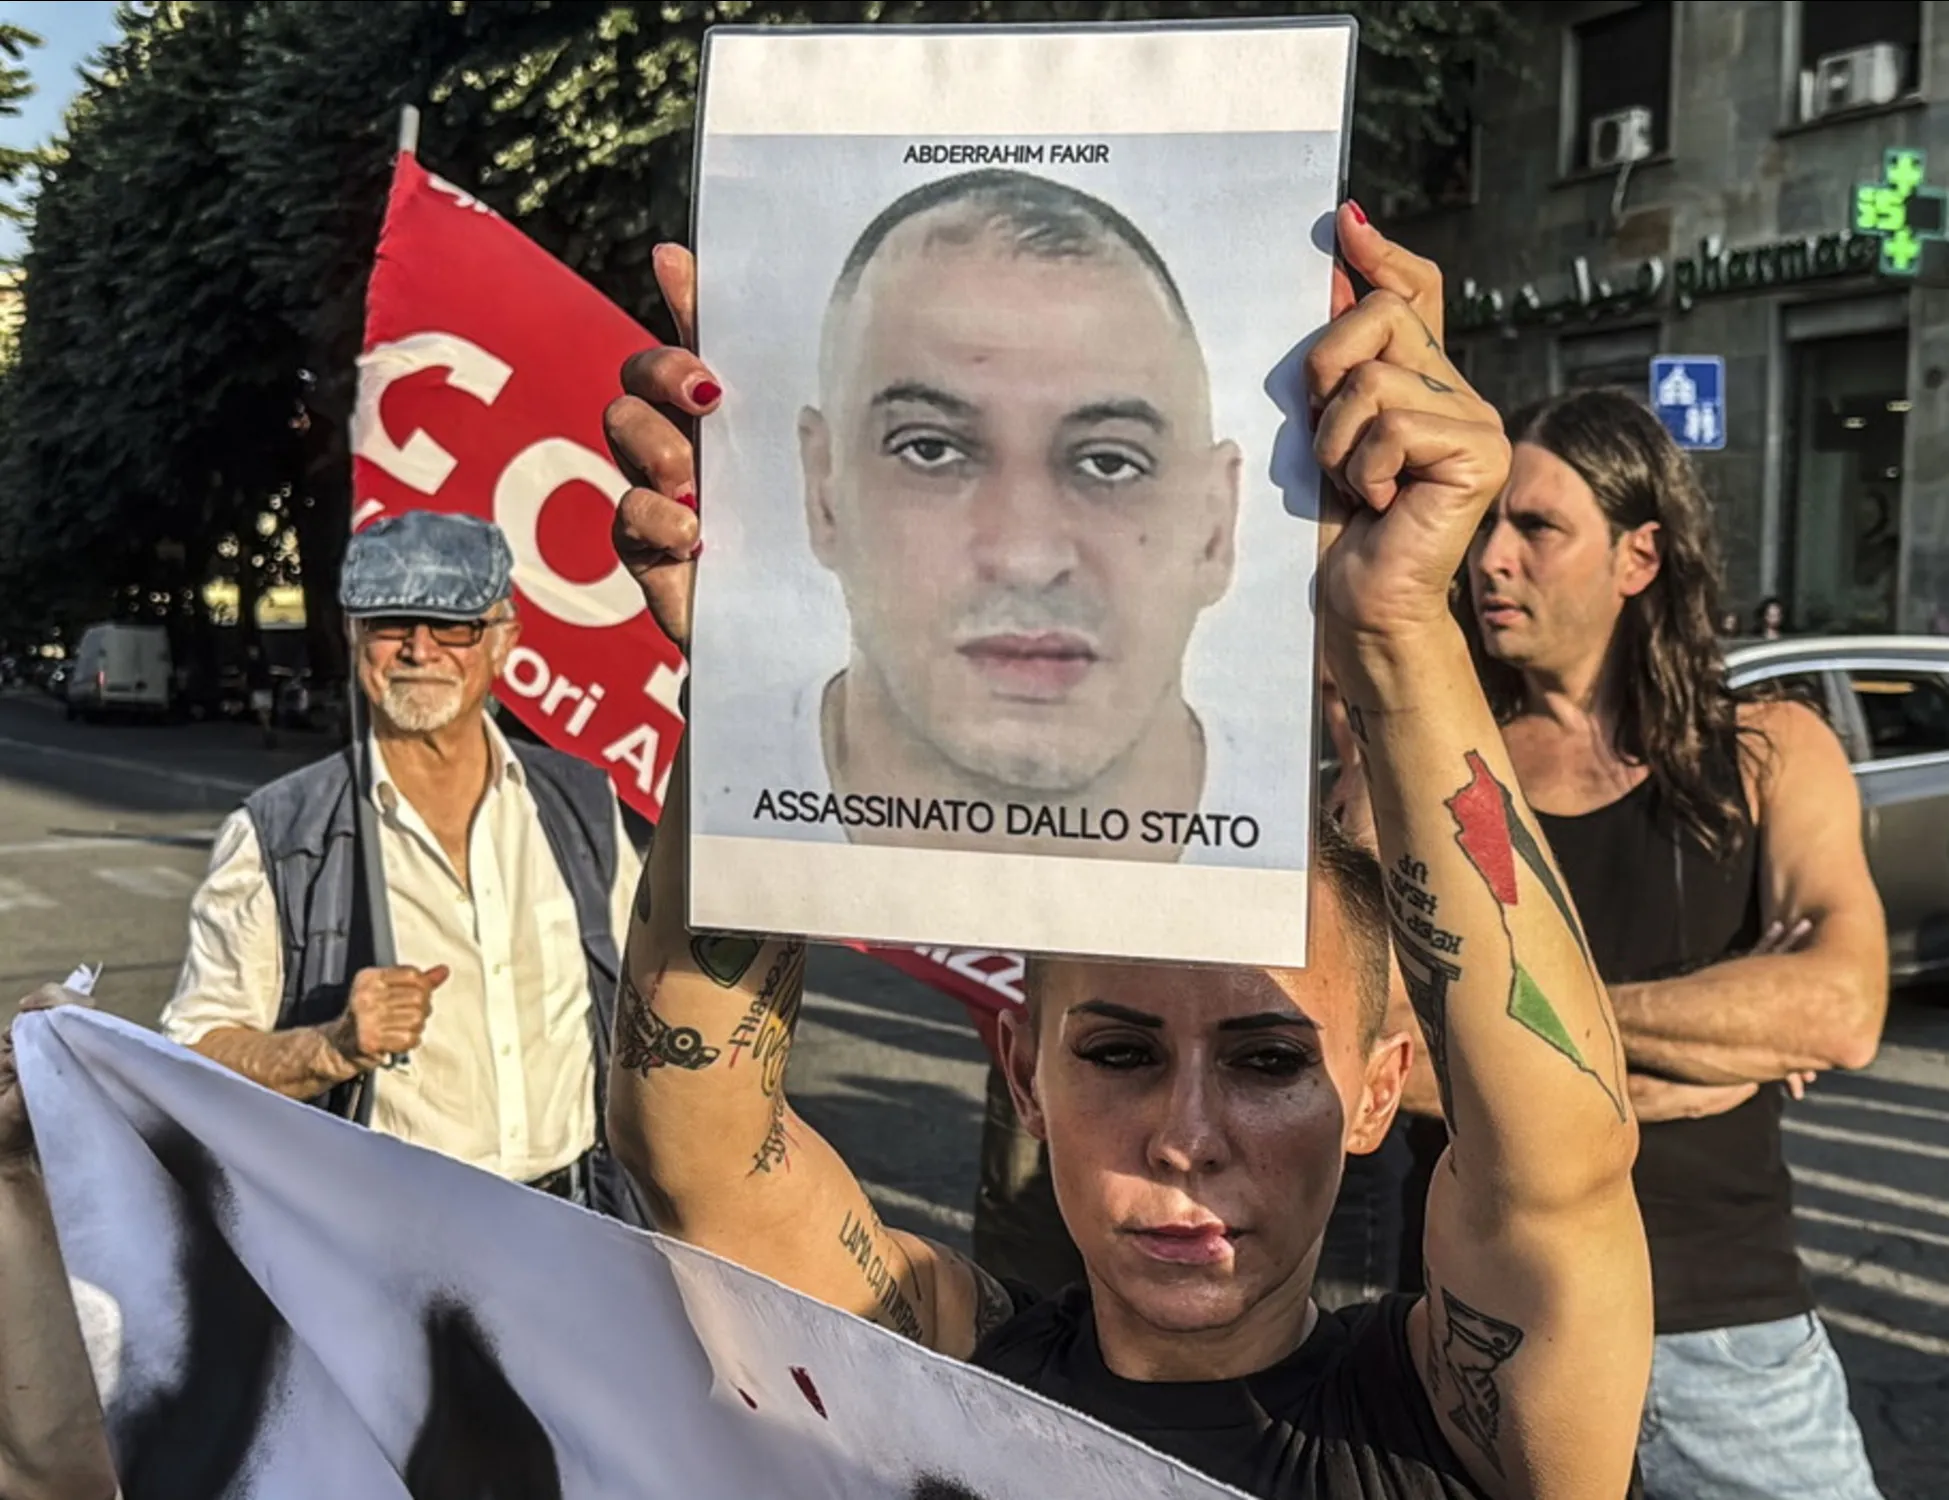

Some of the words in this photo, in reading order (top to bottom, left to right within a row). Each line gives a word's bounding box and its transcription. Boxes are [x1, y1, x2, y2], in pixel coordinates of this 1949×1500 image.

[903, 145, 1043, 163] ABDERRAHIM
[1050, 145, 1109, 163] FAKIR
[753, 789, 994, 833] ASSASSINATO
[1006, 803, 1129, 841] DALLO
[1141, 811, 1260, 848] STATO
